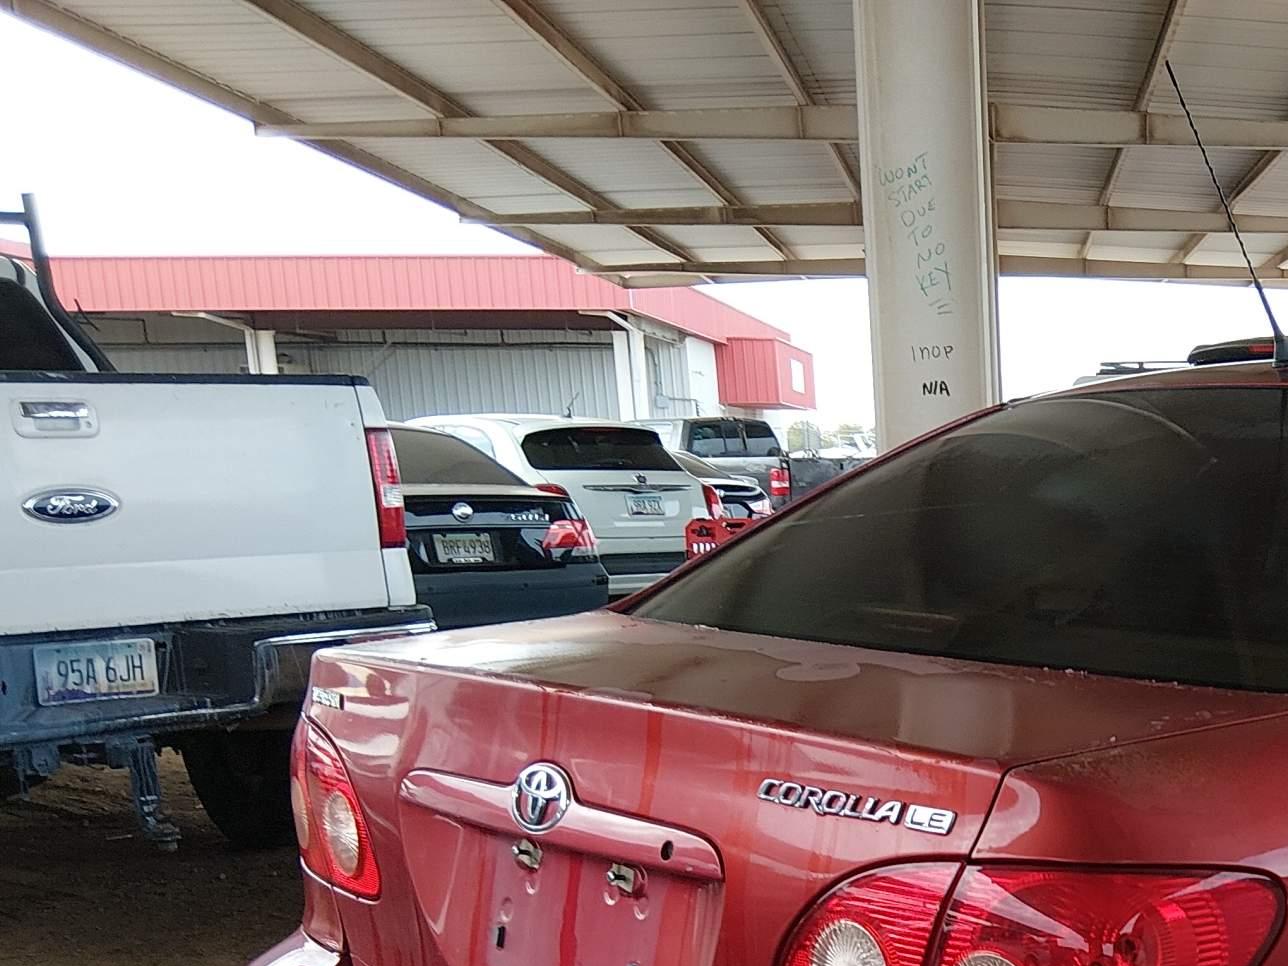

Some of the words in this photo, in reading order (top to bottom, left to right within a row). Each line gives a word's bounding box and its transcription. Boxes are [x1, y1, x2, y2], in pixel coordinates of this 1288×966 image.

[879, 152, 928, 186] WONT
[888, 174, 932, 208] START
[907, 225, 933, 247] TO
[917, 242, 945, 269] NO
[916, 261, 952, 297] KEY
[922, 380, 950, 396] N/A
[47, 495, 98, 515] Ford
[56, 658, 98, 687] 95A
[105, 654, 145, 683] 6JH
[756, 778, 903, 826] COROLLA
[907, 806, 951, 832] LE
